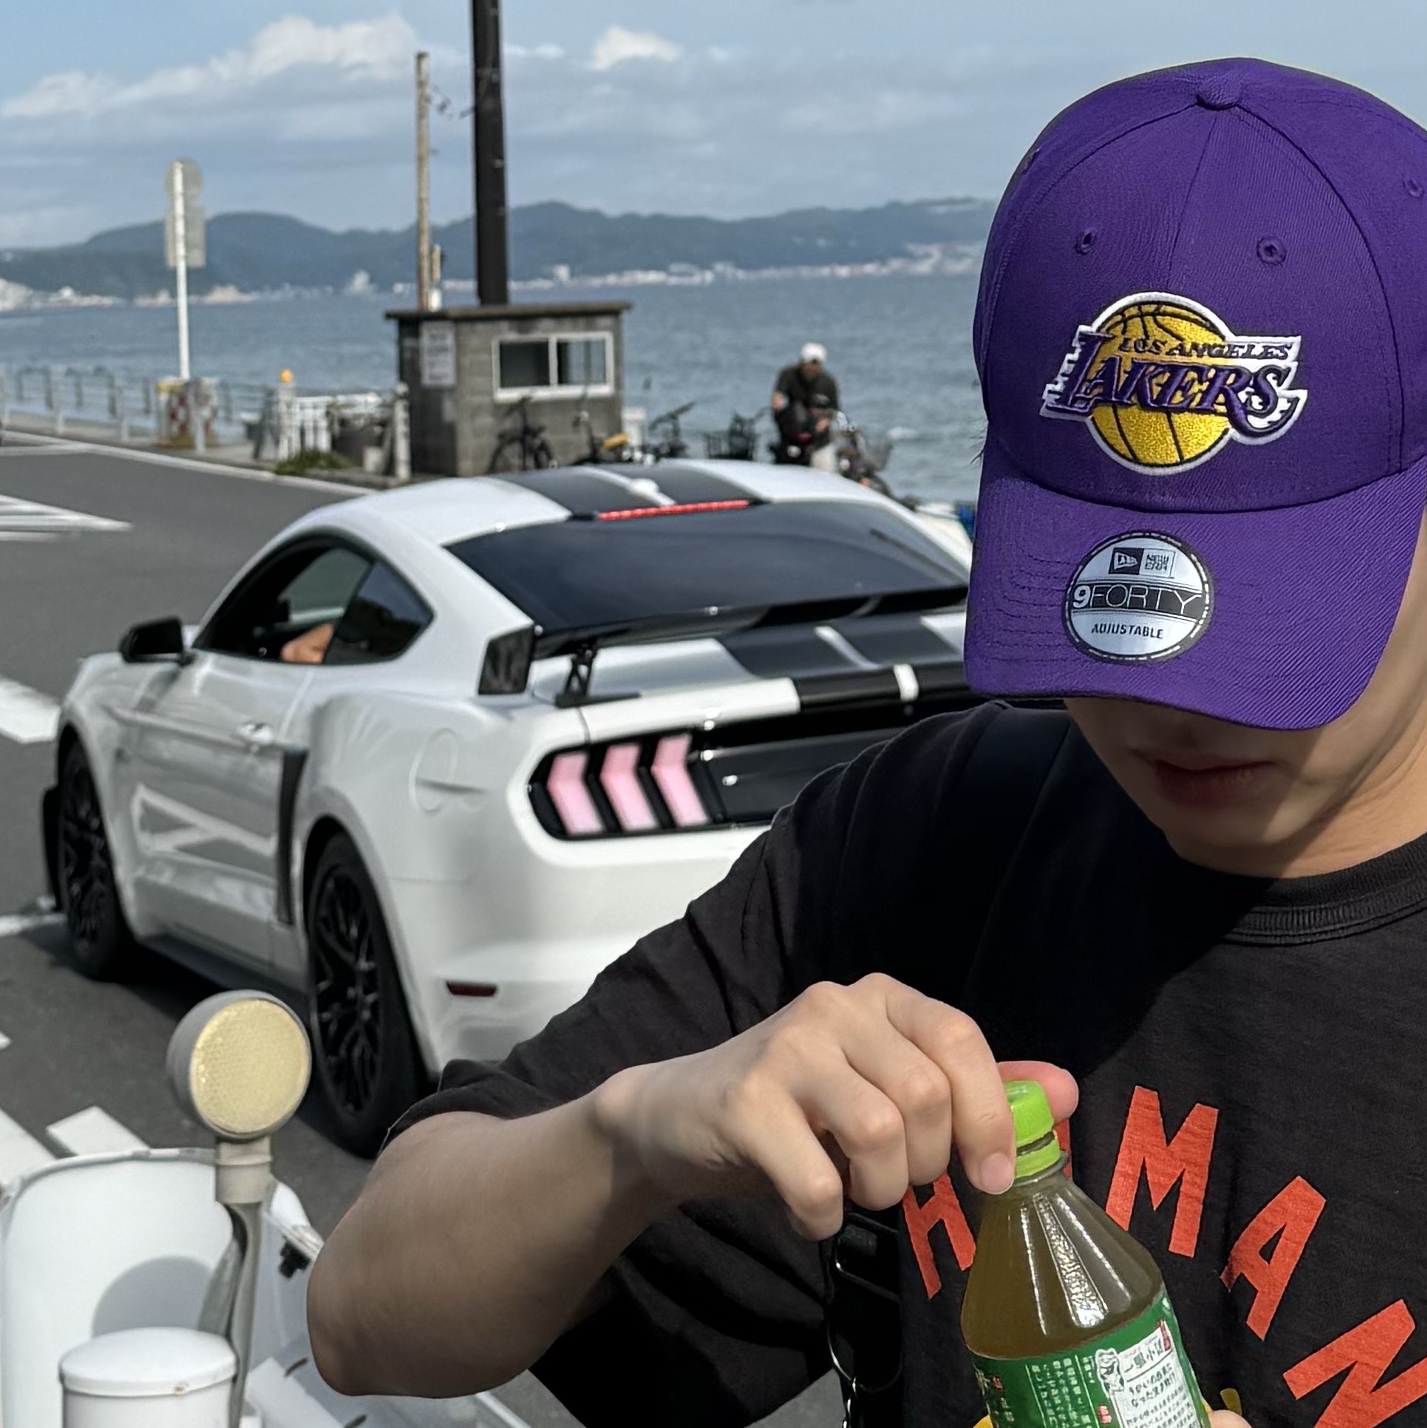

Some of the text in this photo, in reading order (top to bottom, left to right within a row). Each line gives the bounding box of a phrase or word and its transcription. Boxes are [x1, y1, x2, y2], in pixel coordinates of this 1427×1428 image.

[1119, 336, 1293, 360] LOS ANGELES
[1045, 333, 1300, 433] LAKERS
[1072, 583, 1203, 615] 9FORTY
[1090, 623, 1164, 640] ADJUSTABLE
